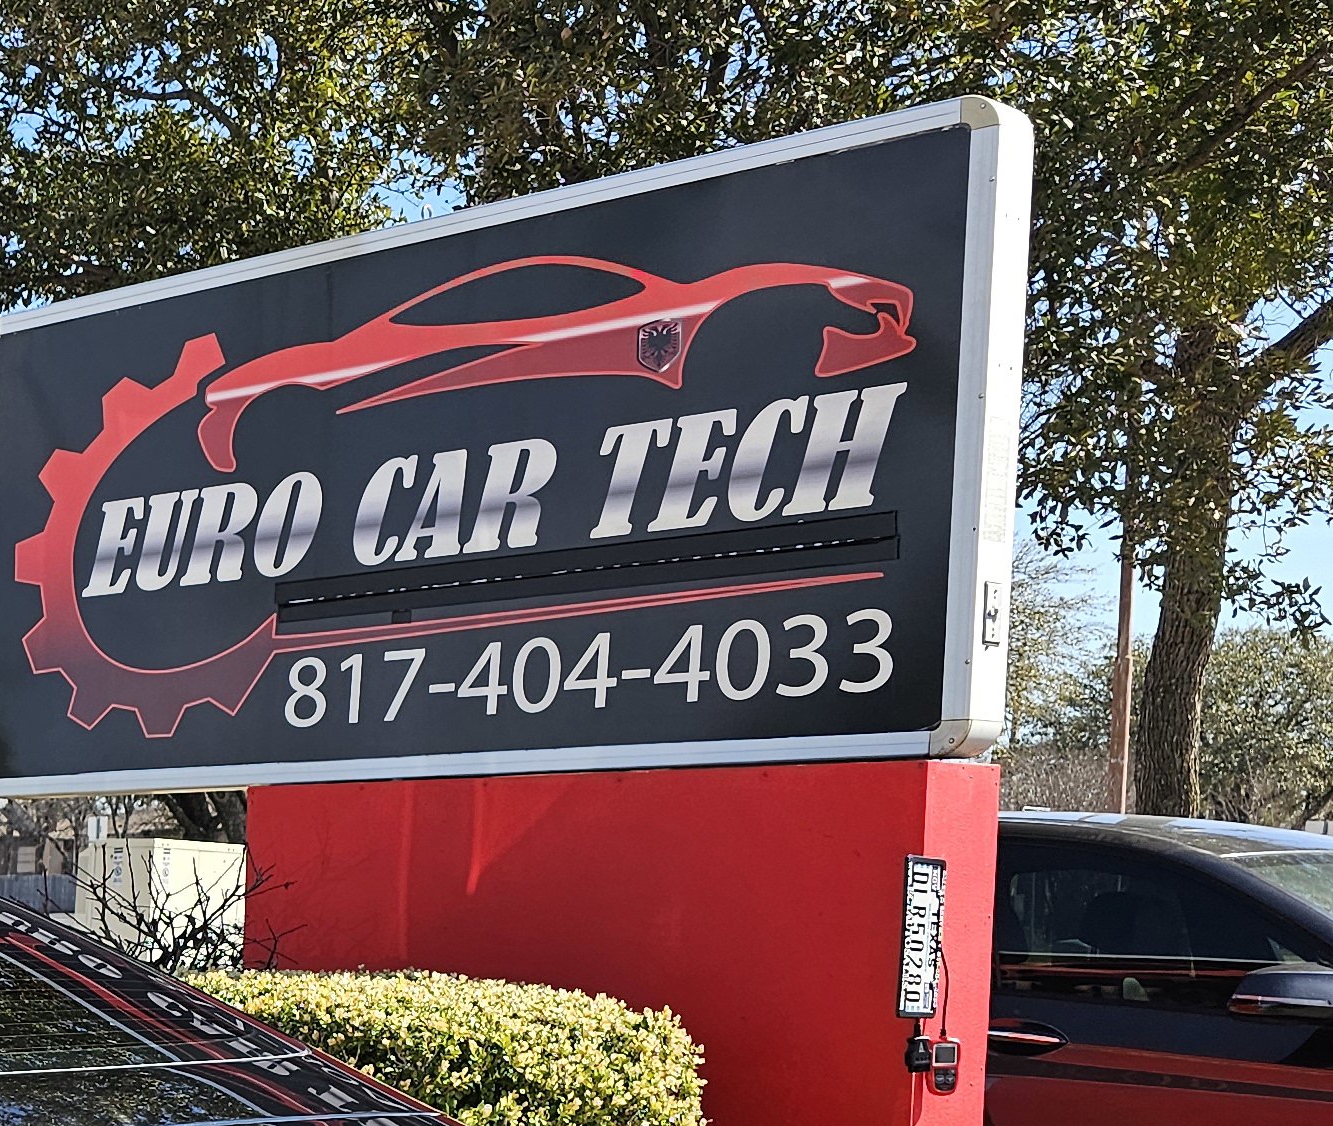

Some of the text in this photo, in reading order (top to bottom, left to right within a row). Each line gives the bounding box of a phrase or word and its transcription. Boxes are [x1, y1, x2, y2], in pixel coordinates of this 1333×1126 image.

[82, 471, 323, 598] EURO
[353, 438, 558, 567] CAR
[589, 382, 908, 539] TECH
[283, 608, 895, 729] 817-404-4033
